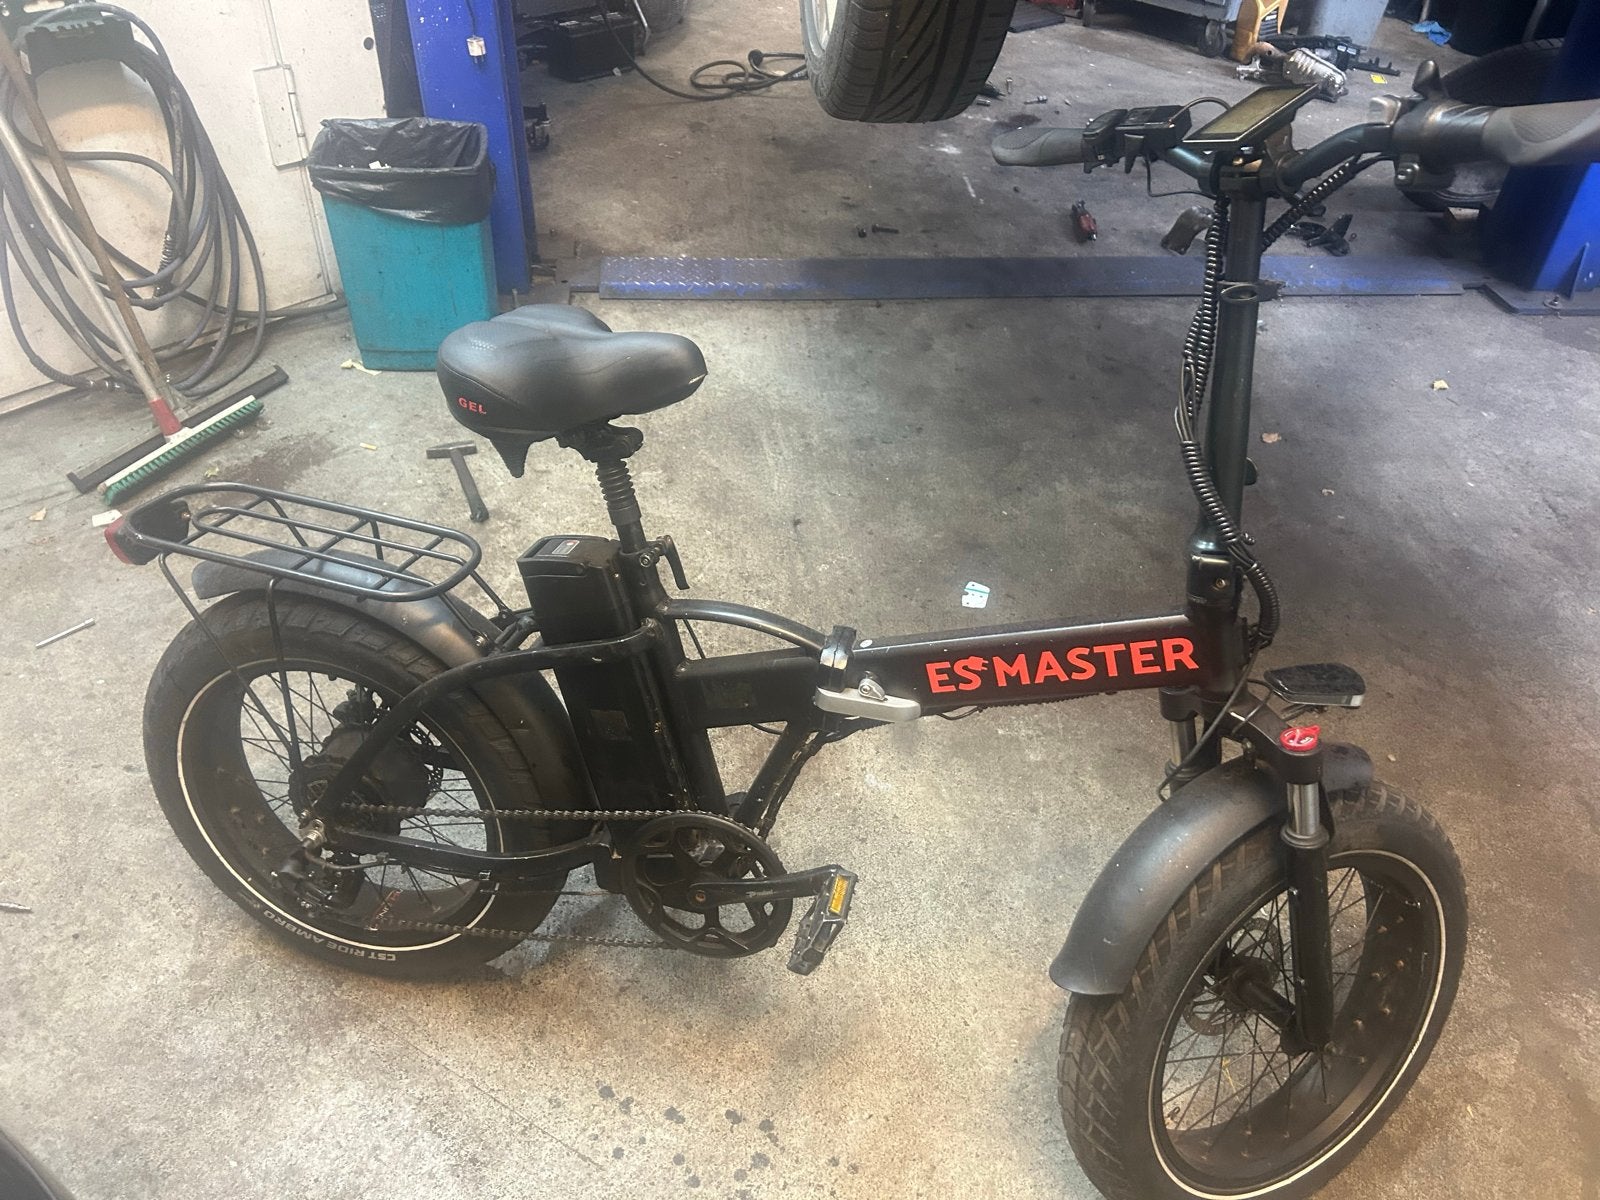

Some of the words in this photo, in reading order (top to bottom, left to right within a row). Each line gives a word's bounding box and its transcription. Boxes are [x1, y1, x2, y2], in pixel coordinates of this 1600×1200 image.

[458, 397, 487, 415] GEL
[263, 909, 325, 944] AMBRO
[326, 941, 365, 957] RIDE
[368, 952, 397, 962] CST
